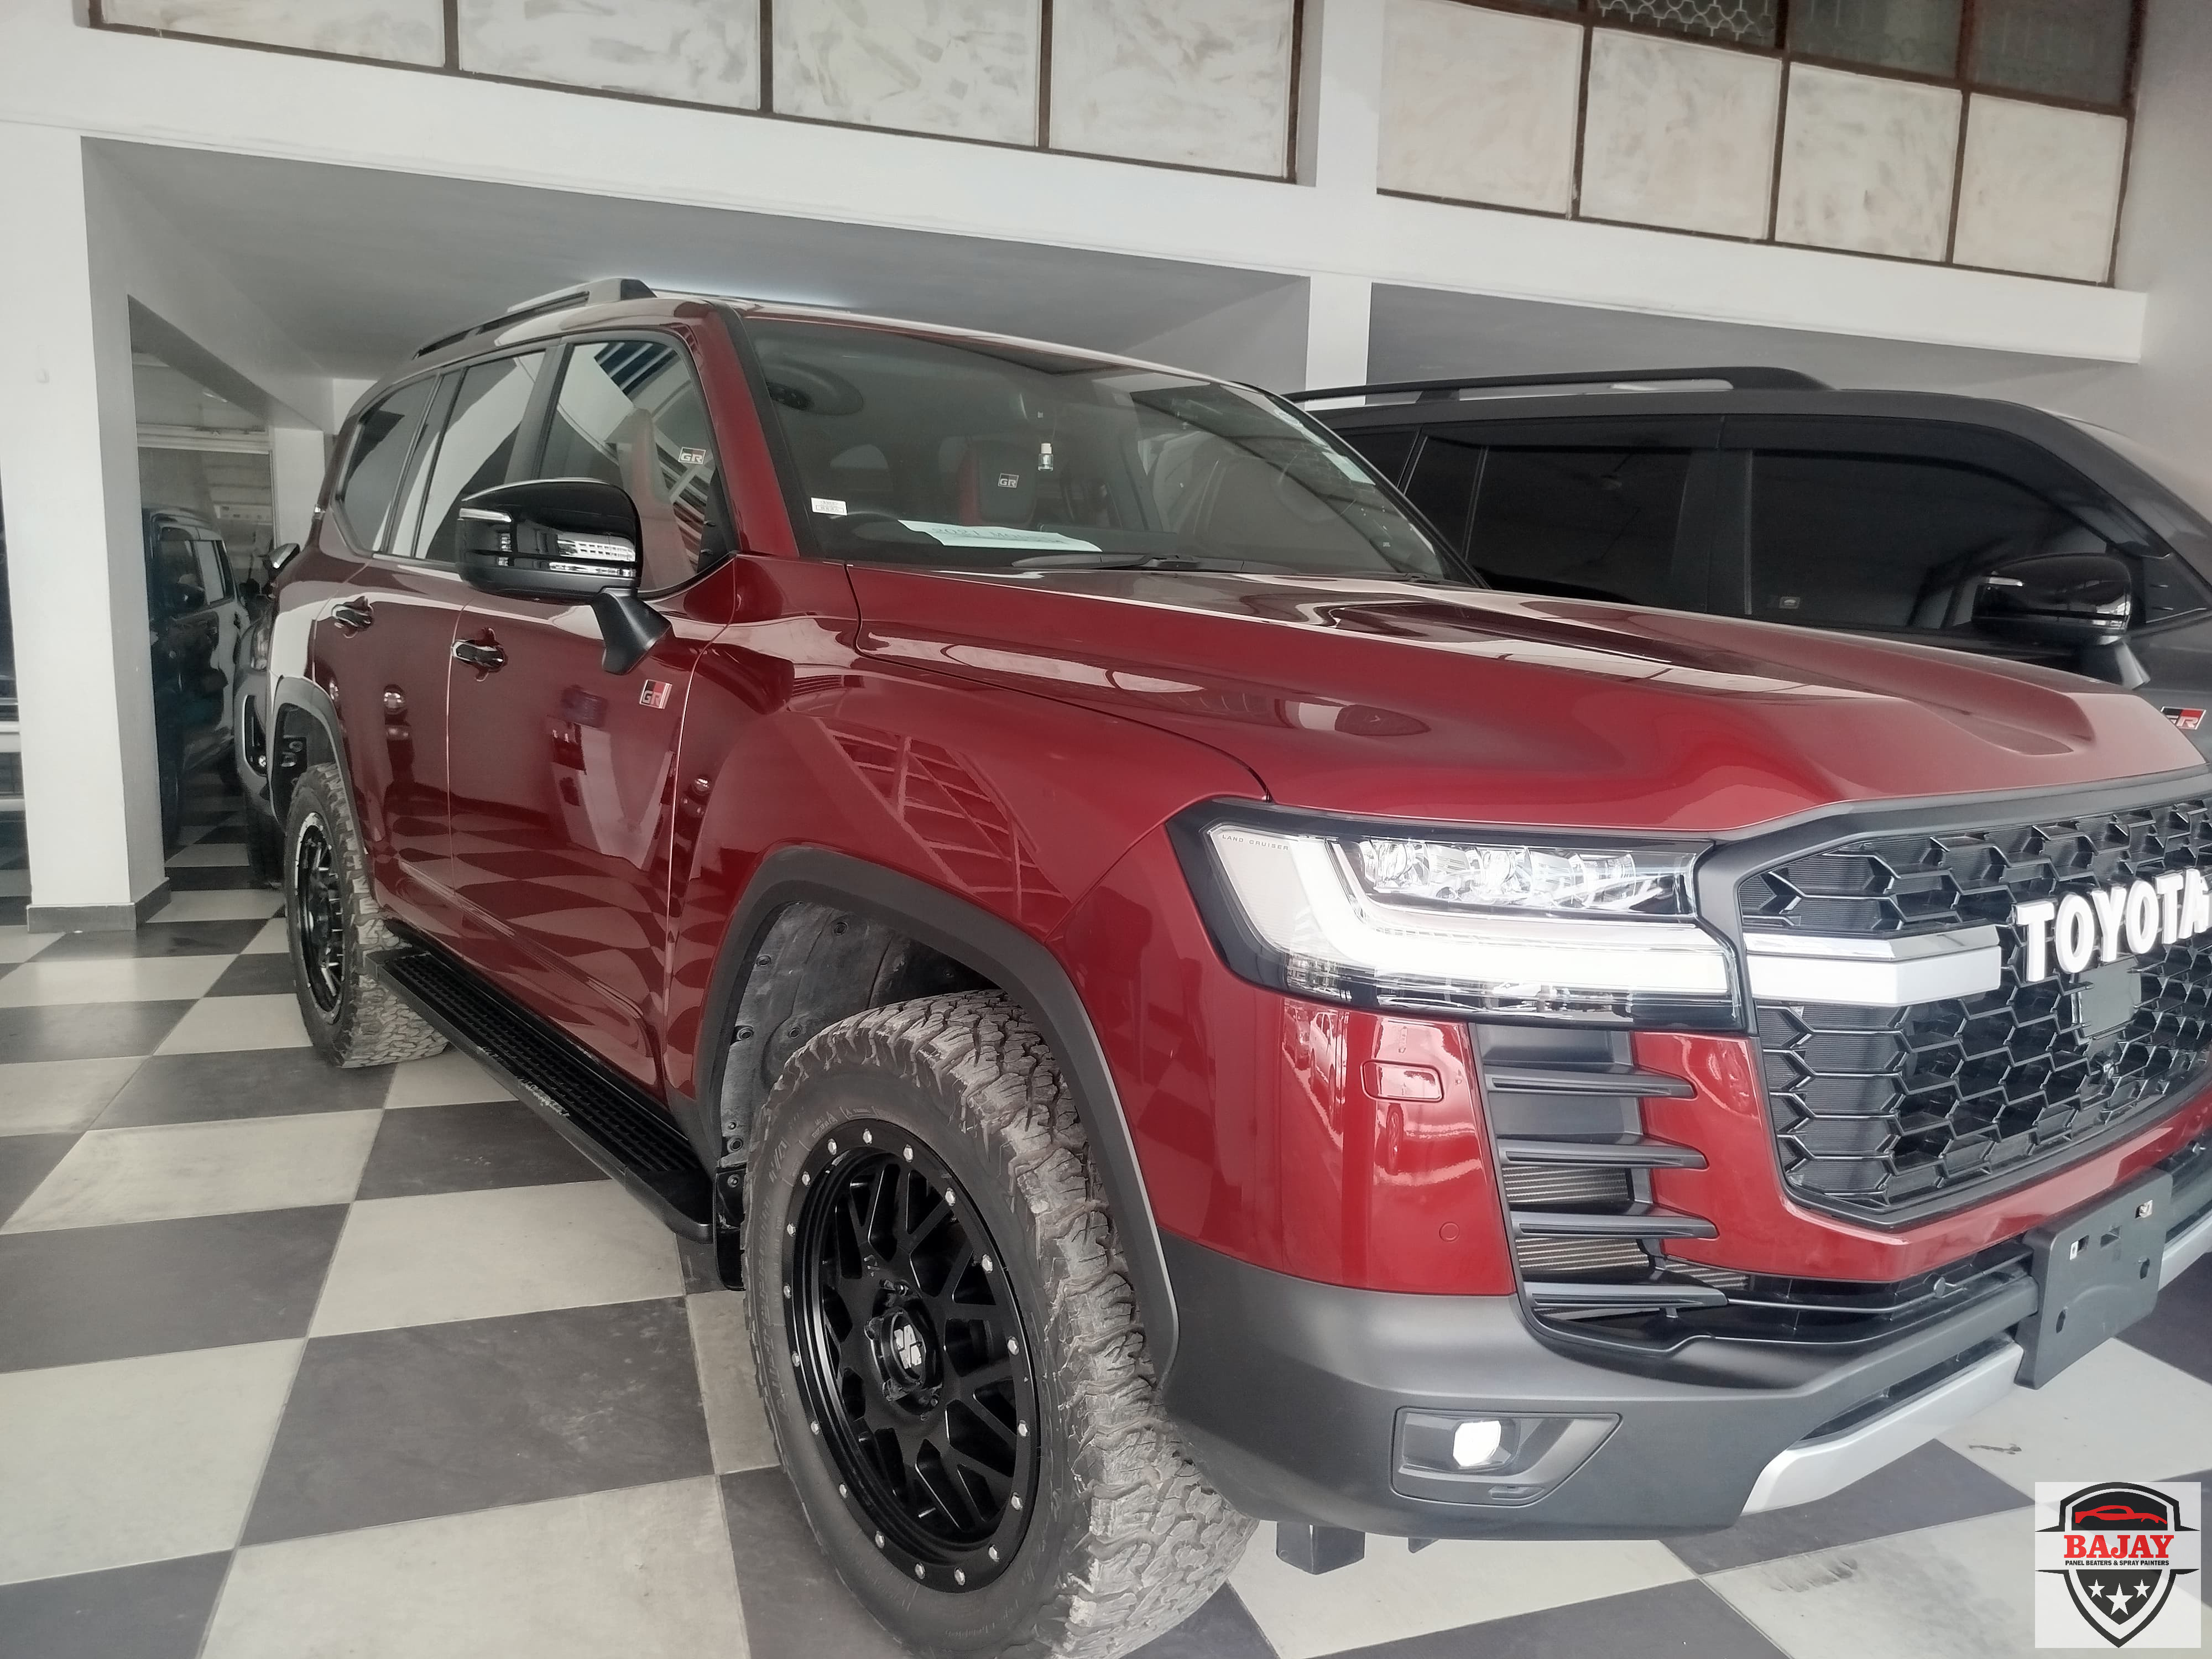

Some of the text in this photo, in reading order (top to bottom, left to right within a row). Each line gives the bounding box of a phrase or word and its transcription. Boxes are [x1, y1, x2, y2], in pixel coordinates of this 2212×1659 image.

[681, 453, 703, 463] GR
[999, 478, 1016, 487] GR
[642, 690, 662, 707] GR
[1222, 834, 1289, 851] LAND CRUISER
[2016, 868, 2210, 983] TOYOTA
